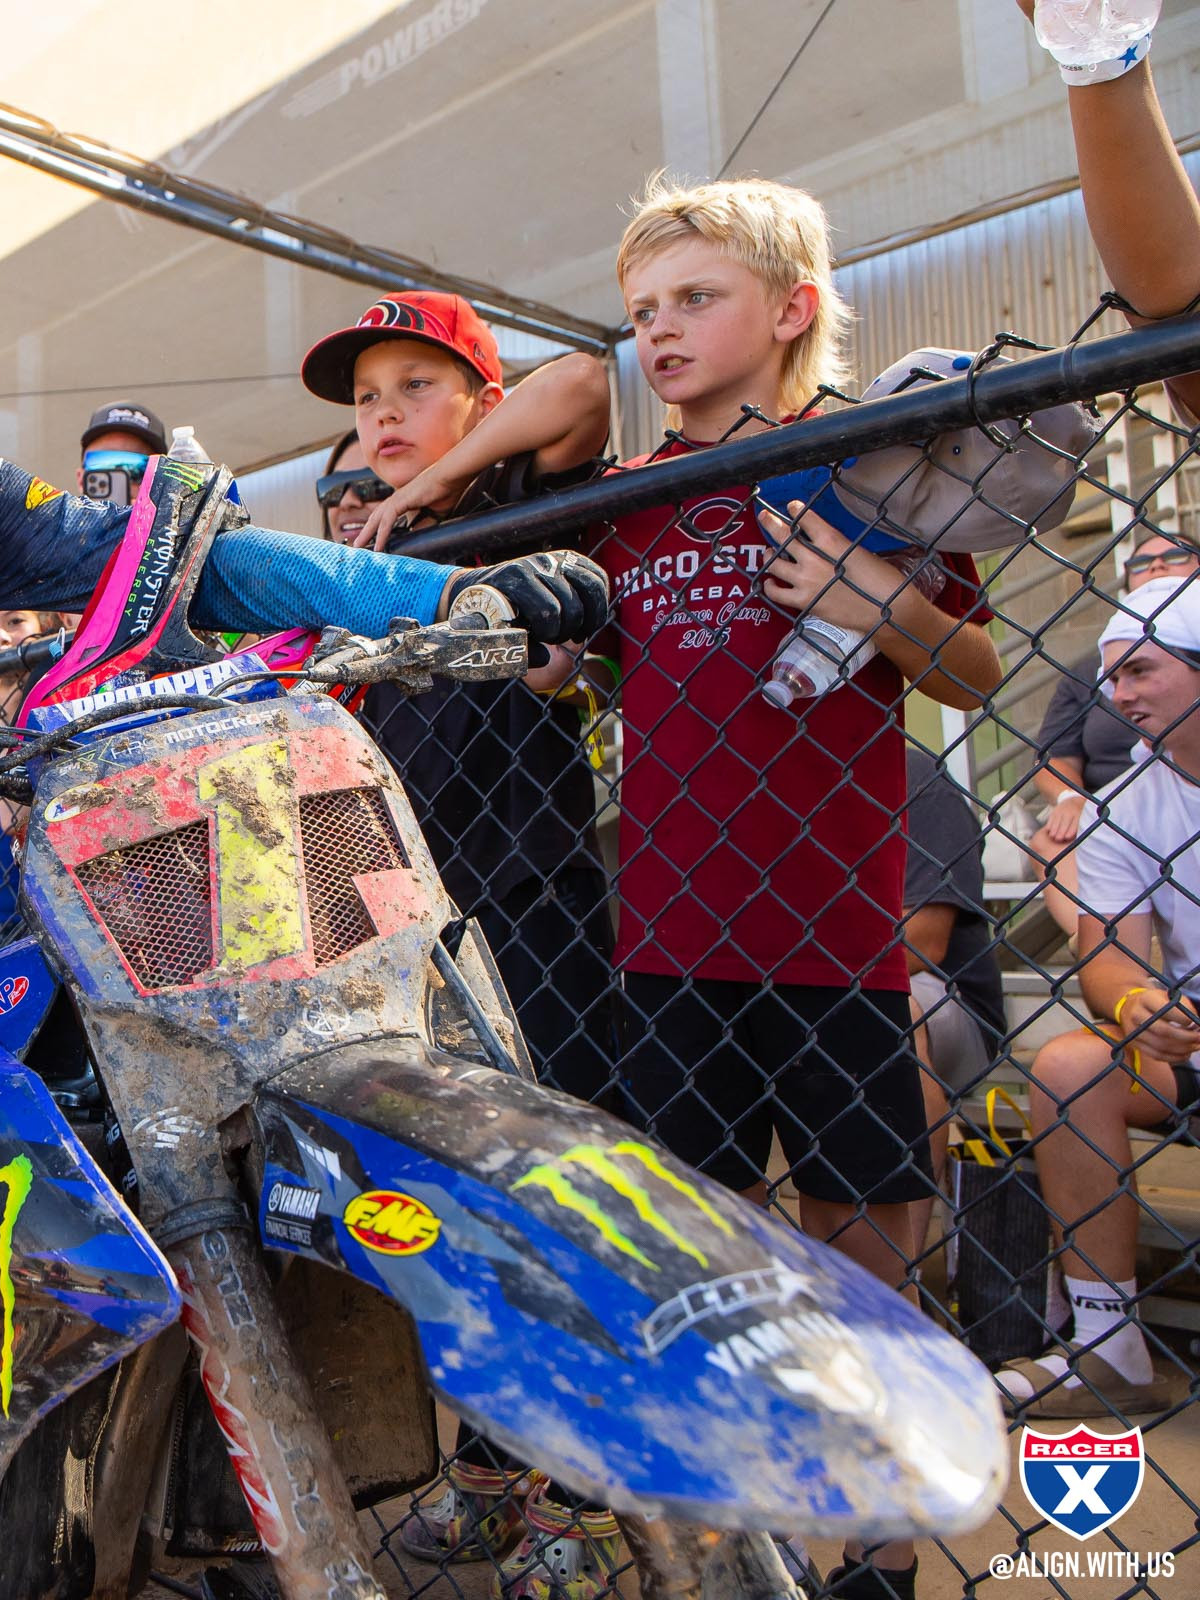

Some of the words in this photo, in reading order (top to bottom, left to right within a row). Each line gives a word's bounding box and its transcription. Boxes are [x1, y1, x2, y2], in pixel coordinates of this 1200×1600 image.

[124, 538, 155, 617] ENERGY
[130, 526, 177, 635] MONSTER
[448, 645, 525, 668] ARC
[278, 1186, 321, 1220] YAMAHA
[344, 1197, 442, 1243] FMF
[1073, 1295, 1125, 1313] VAN
